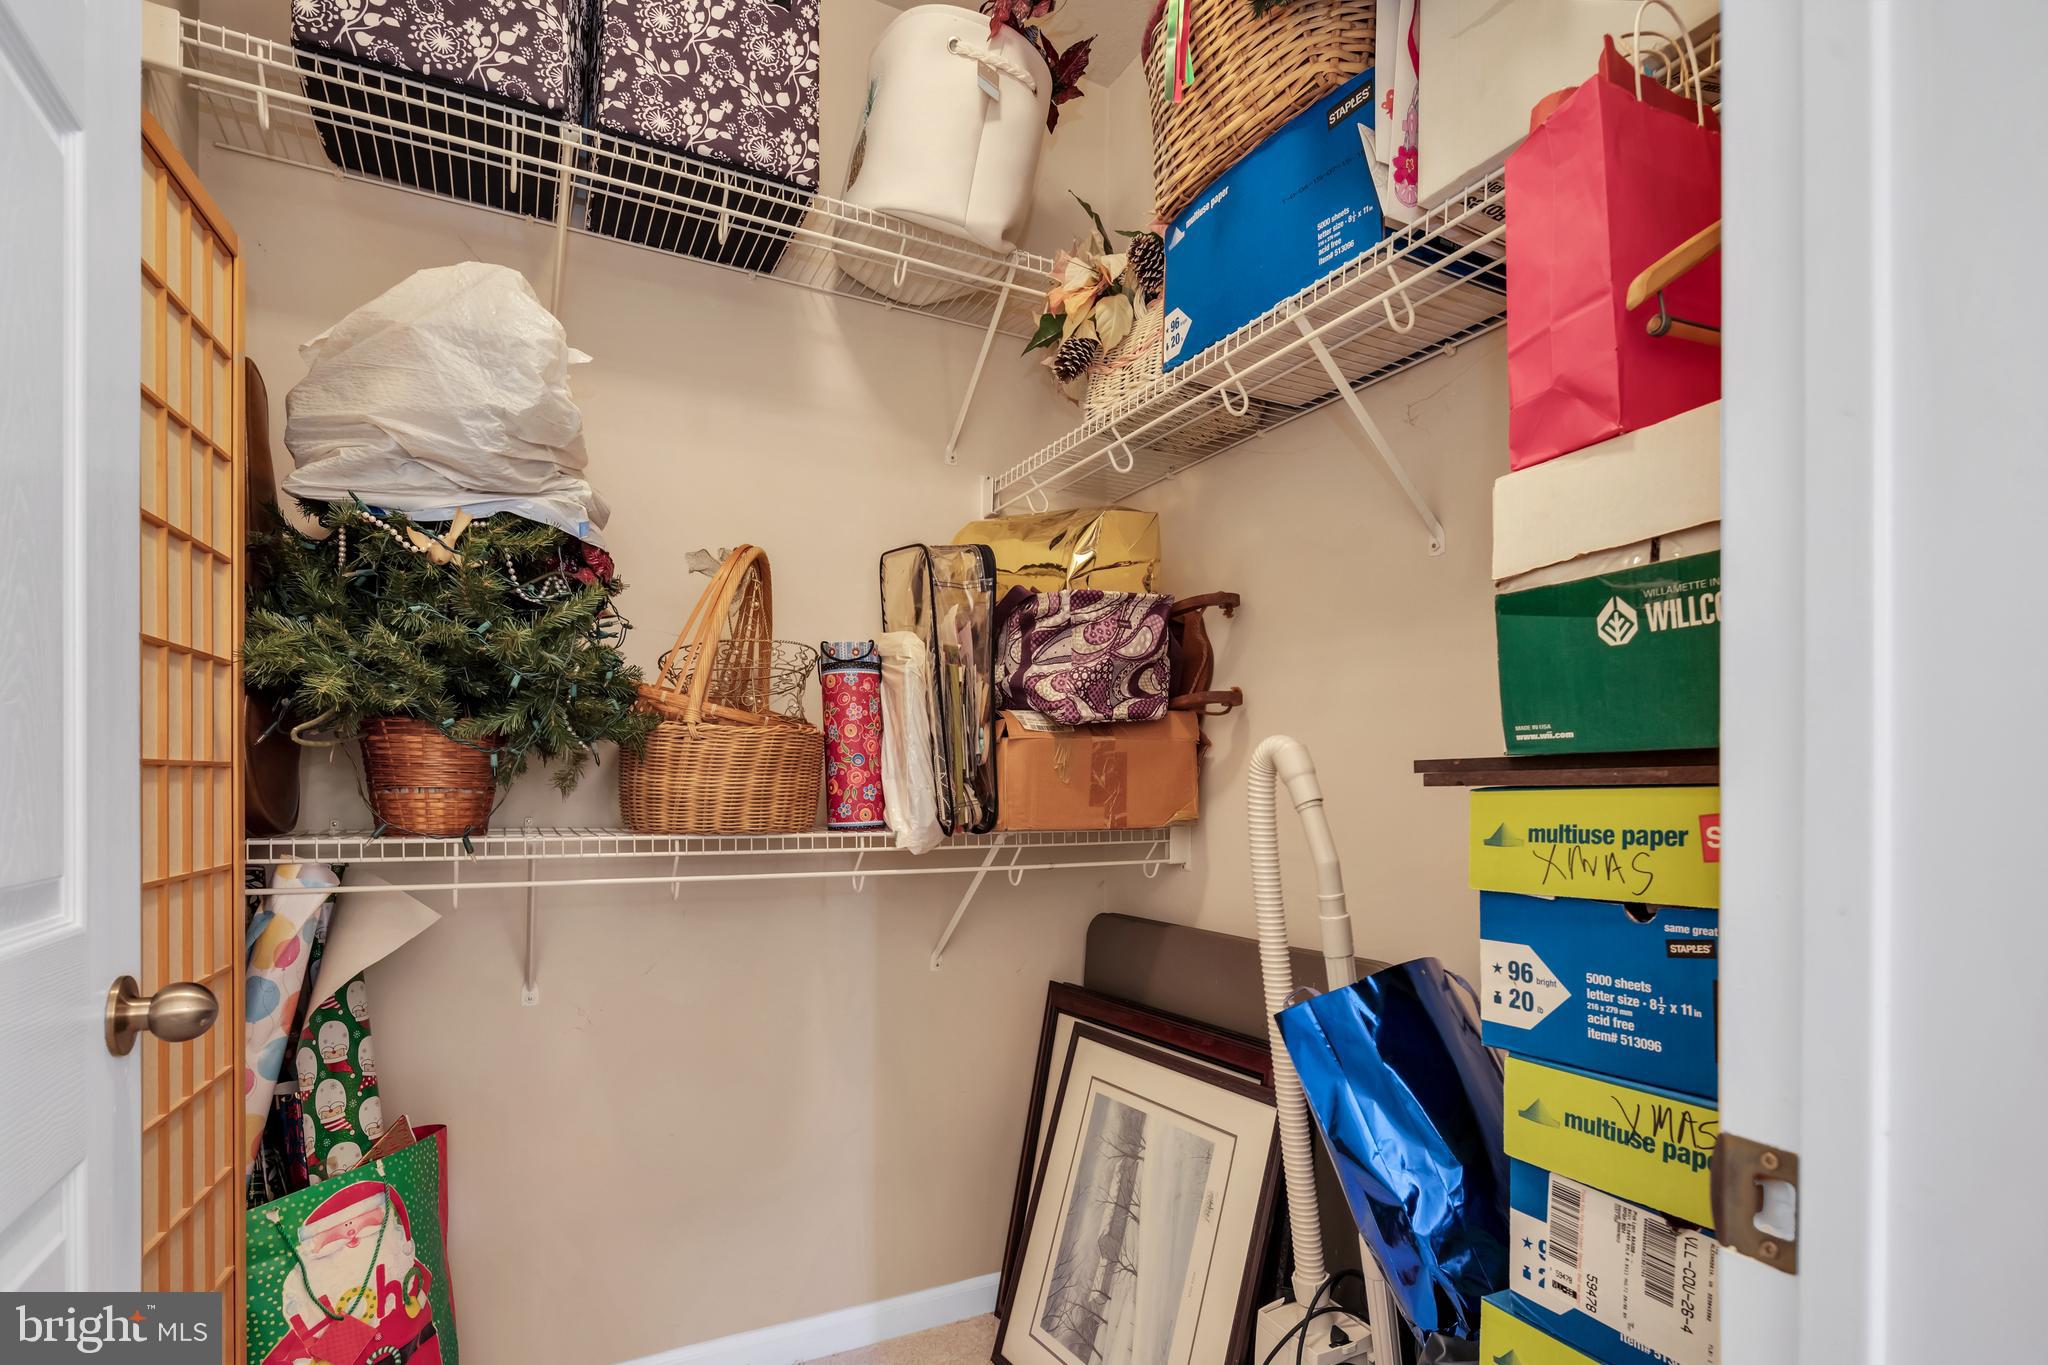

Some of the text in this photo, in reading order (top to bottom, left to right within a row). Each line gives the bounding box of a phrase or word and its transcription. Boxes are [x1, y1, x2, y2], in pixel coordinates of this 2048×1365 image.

[1328, 86, 1370, 125] STAPLES
[1185, 186, 1229, 229] multiuse paper
[1317, 207, 1350, 231] 5000 sheets
[1317, 228, 1332, 241] letter
[1332, 221, 1345, 232] size
[1318, 243, 1330, 256] acid
[1330, 238, 1342, 249] free
[1170, 316, 1180, 332] 96
[1170, 332, 1180, 349] 20
[1642, 579, 1706, 598] WILLAMETTE
[1528, 824, 1689, 851] multiuse paper
[1664, 923, 1719, 937] same great
[1669, 944, 1711, 954] STAPLES
[1507, 960, 1557, 988] 96 bright
[1586, 972, 1652, 993] 5000 sheets
[1508, 988, 1544, 1015] 20 lb
[1586, 988, 1614, 1003] letter
[1617, 994, 1640, 1008] size
[1670, 1004, 1678, 1014] x
[1586, 1002, 1599, 1011] 216
[1605, 1004, 1618, 1014] 279
[1619, 1008, 1633, 1017] mm
[1587, 1013, 1635, 1032] acid free
[1587, 1028, 1662, 1053] item# 513096
[1564, 1111, 1656, 1153] multiuse
[1611, 1095, 1718, 1150] XMAS
[1586, 1274, 1598, 1314] 59478
[1680, 1236, 1697, 1336] VLL-COU-26-4
